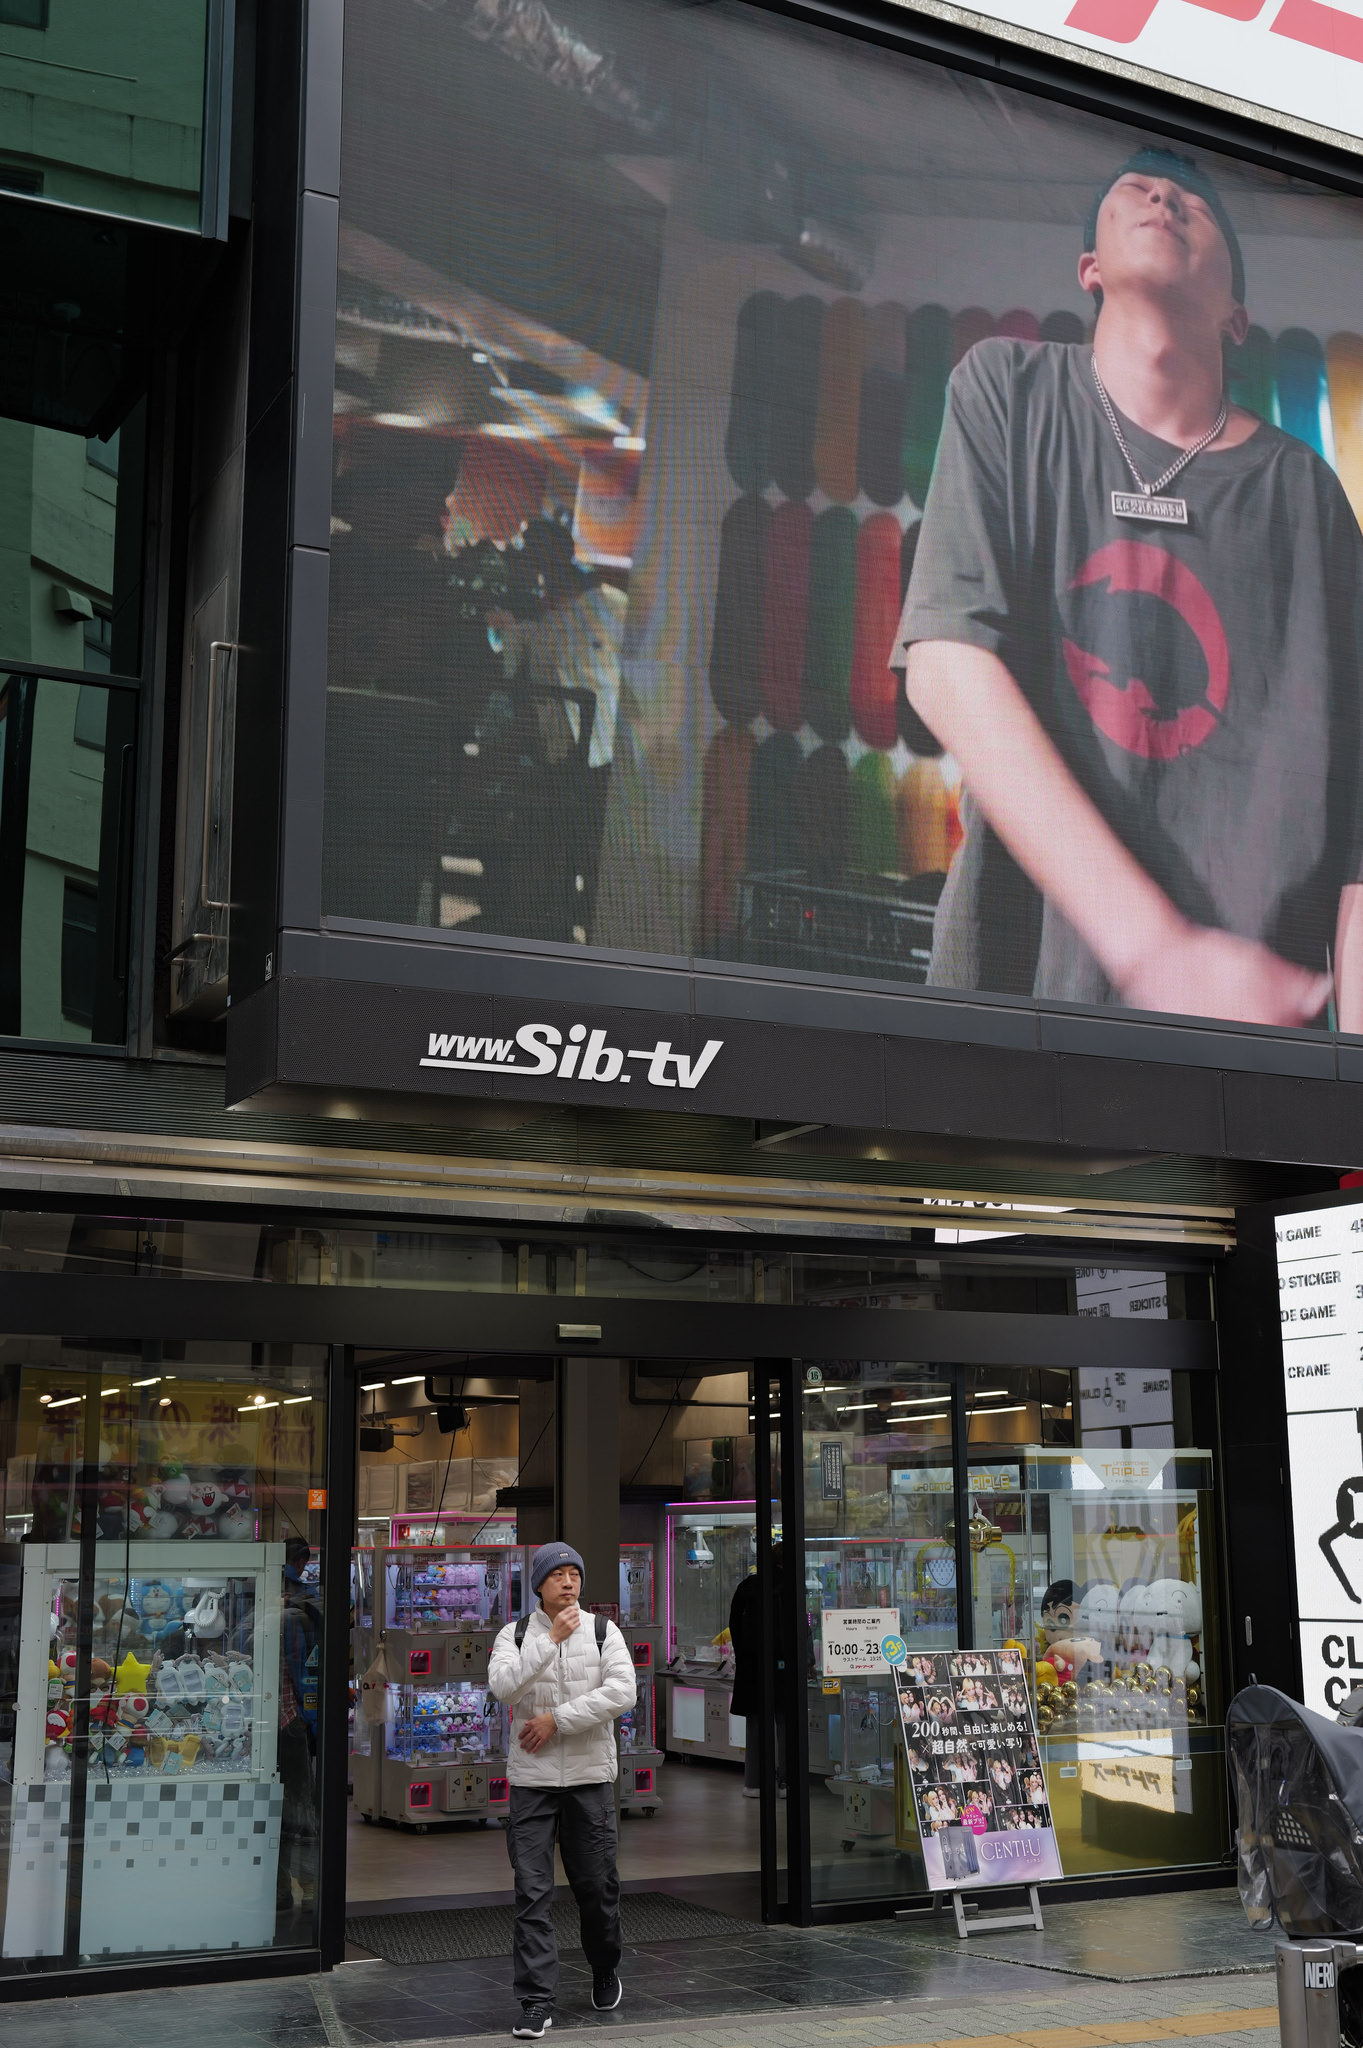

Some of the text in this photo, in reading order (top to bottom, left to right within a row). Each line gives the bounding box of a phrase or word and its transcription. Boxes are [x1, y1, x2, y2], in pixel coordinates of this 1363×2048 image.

[1286, 1225, 1322, 1242] GAME
[1288, 1270, 1341, 1289] STICKER
[1299, 1304, 1337, 1320] GAME
[1287, 1363, 1331, 1379] CRANE
[828, 1643, 858, 1656] 10:00
[1304, 1961, 1335, 1988] NERO
